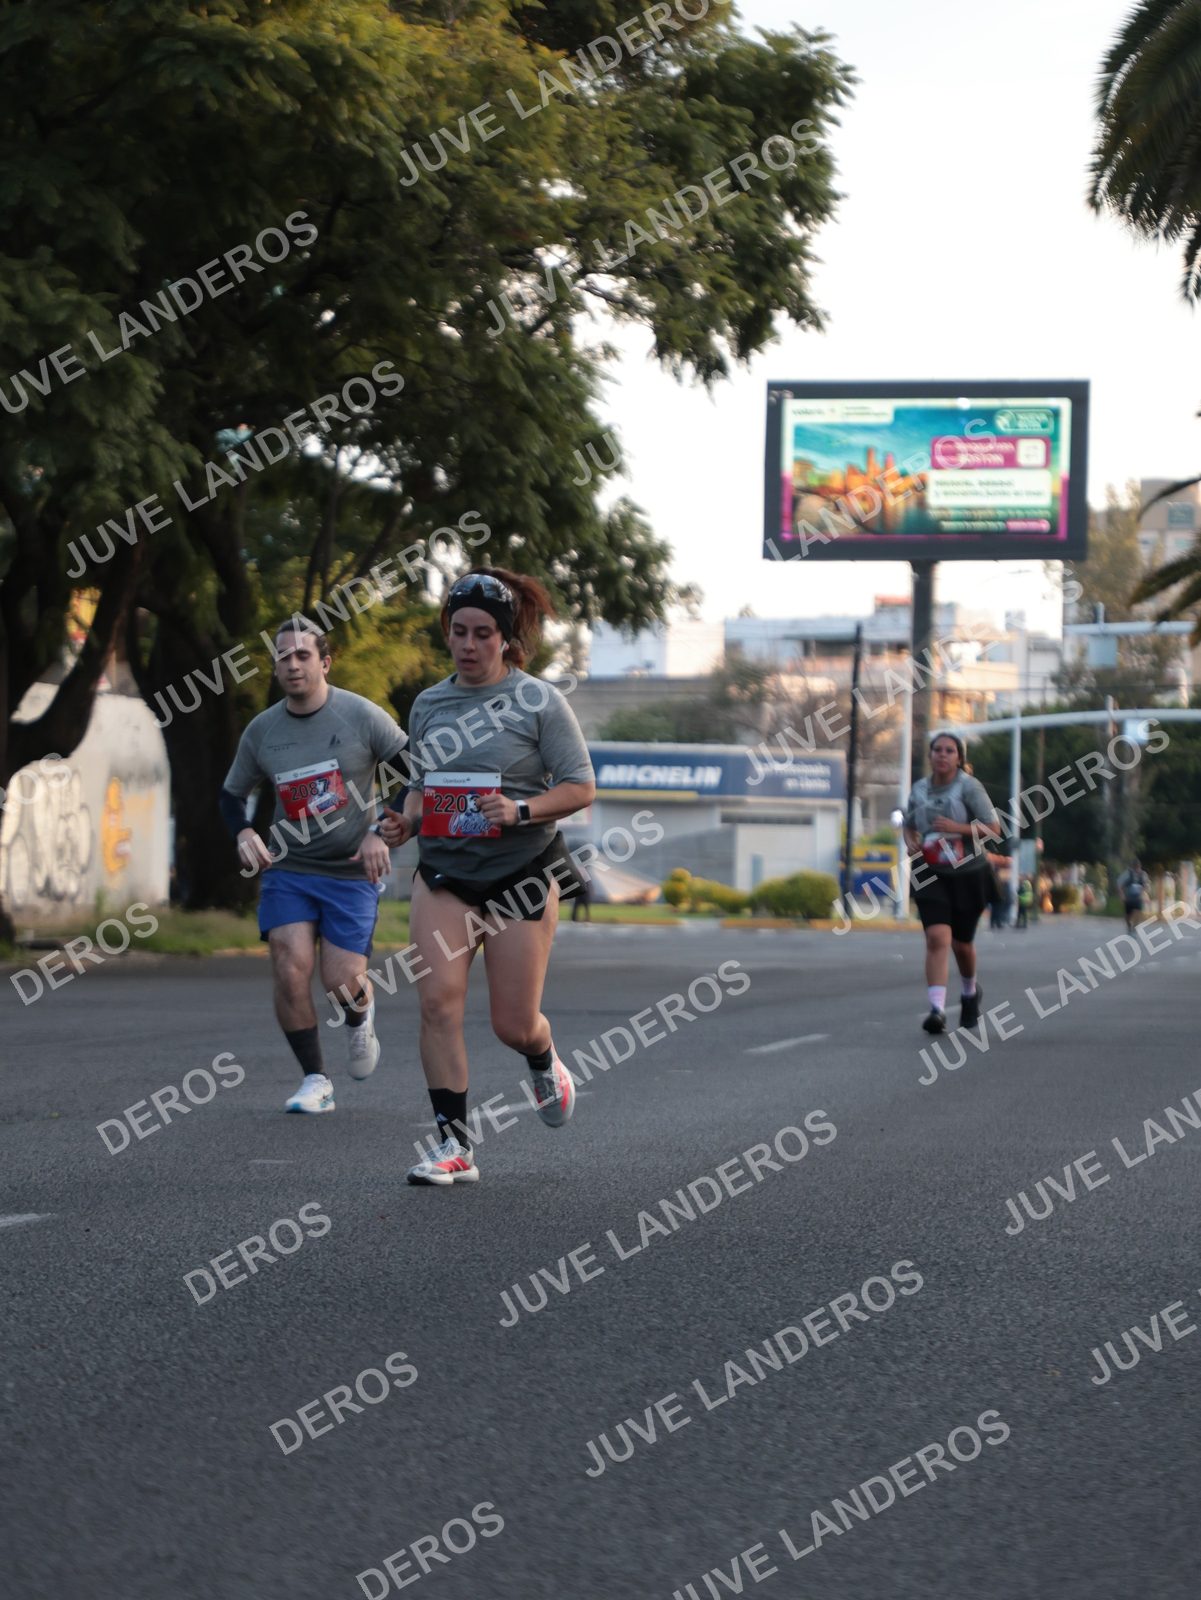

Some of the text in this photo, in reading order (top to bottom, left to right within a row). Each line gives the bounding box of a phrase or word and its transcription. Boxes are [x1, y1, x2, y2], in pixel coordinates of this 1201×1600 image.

[598, 764, 722, 788] MICHELIN
[290, 778, 329, 801] 2087
[434, 793, 482, 814] 2203
